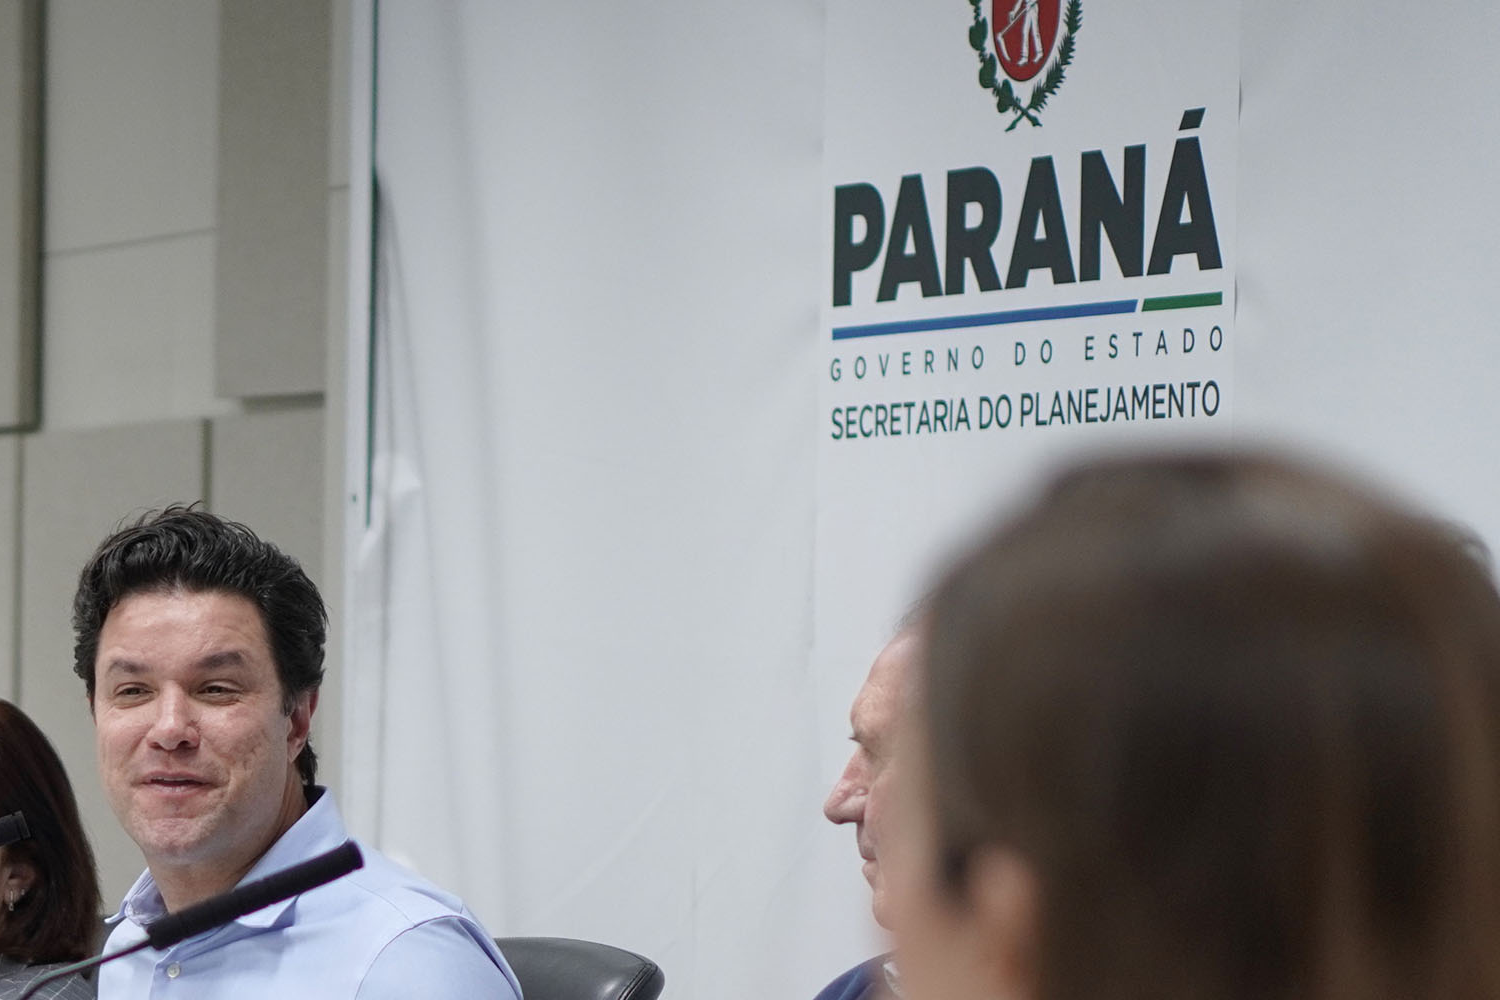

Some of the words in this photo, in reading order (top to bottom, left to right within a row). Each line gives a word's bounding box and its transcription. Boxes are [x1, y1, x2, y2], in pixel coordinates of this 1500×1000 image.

[833, 107, 1223, 307] PARANÁ
[830, 345, 985, 382] GOVERNO
[1014, 339, 1054, 366] DO
[1084, 325, 1224, 361] ESTADO
[831, 397, 971, 440] SECRETARIA
[979, 394, 1012, 430] DO
[1019, 380, 1221, 428] PLANEJAMENTO
